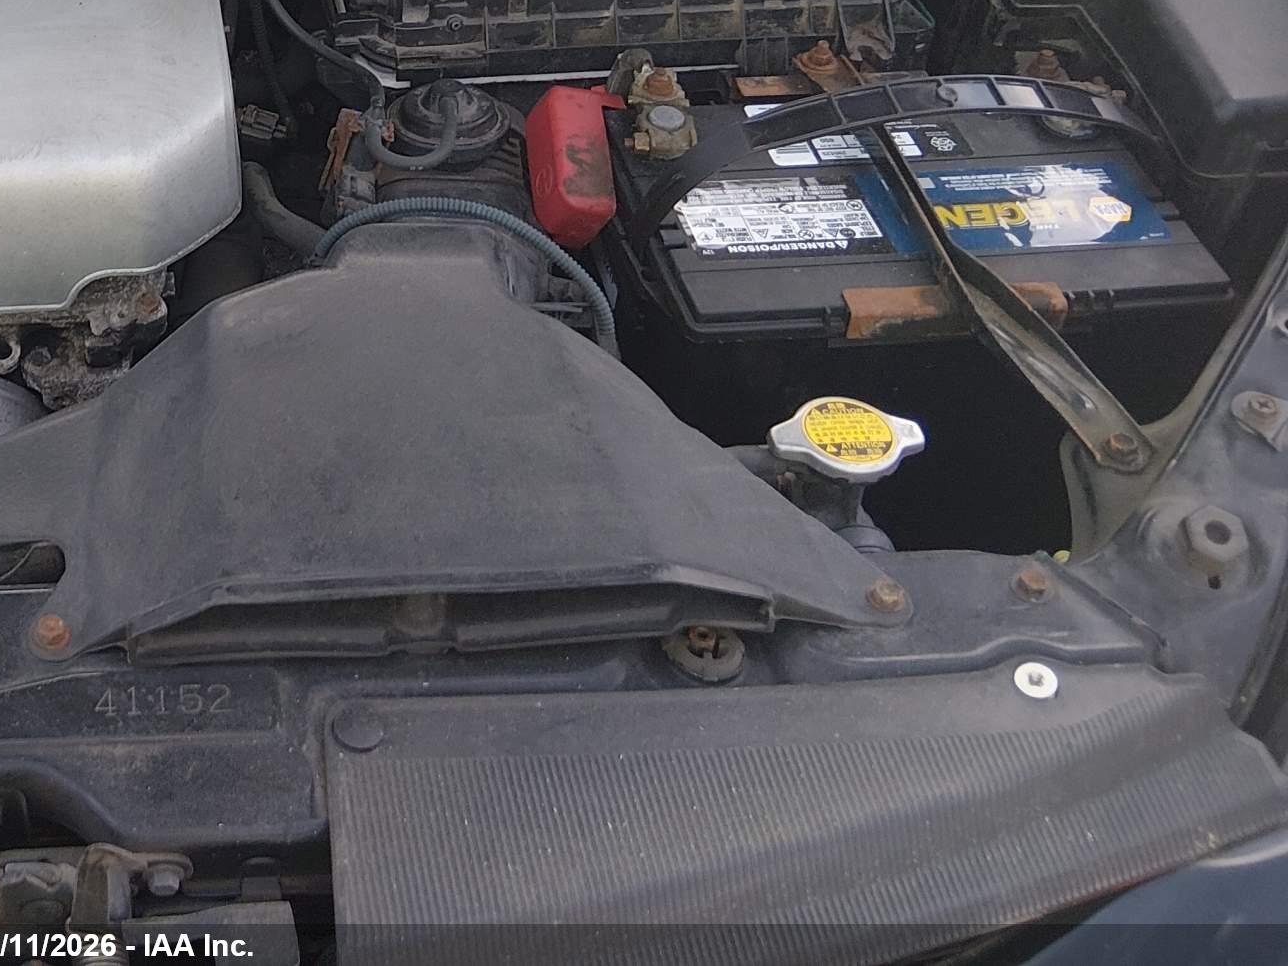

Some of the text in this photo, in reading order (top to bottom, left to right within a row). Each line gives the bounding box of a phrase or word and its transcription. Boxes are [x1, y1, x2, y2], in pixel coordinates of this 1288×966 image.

[935, 201, 1081, 228] LEGEN
[1094, 202, 1128, 216] NAPA
[728, 241, 835, 253] DANGER/POISON
[822, 407, 865, 415] CAUTION
[841, 441, 886, 450] ATTENTION
[94, 683, 233, 717] 41152
